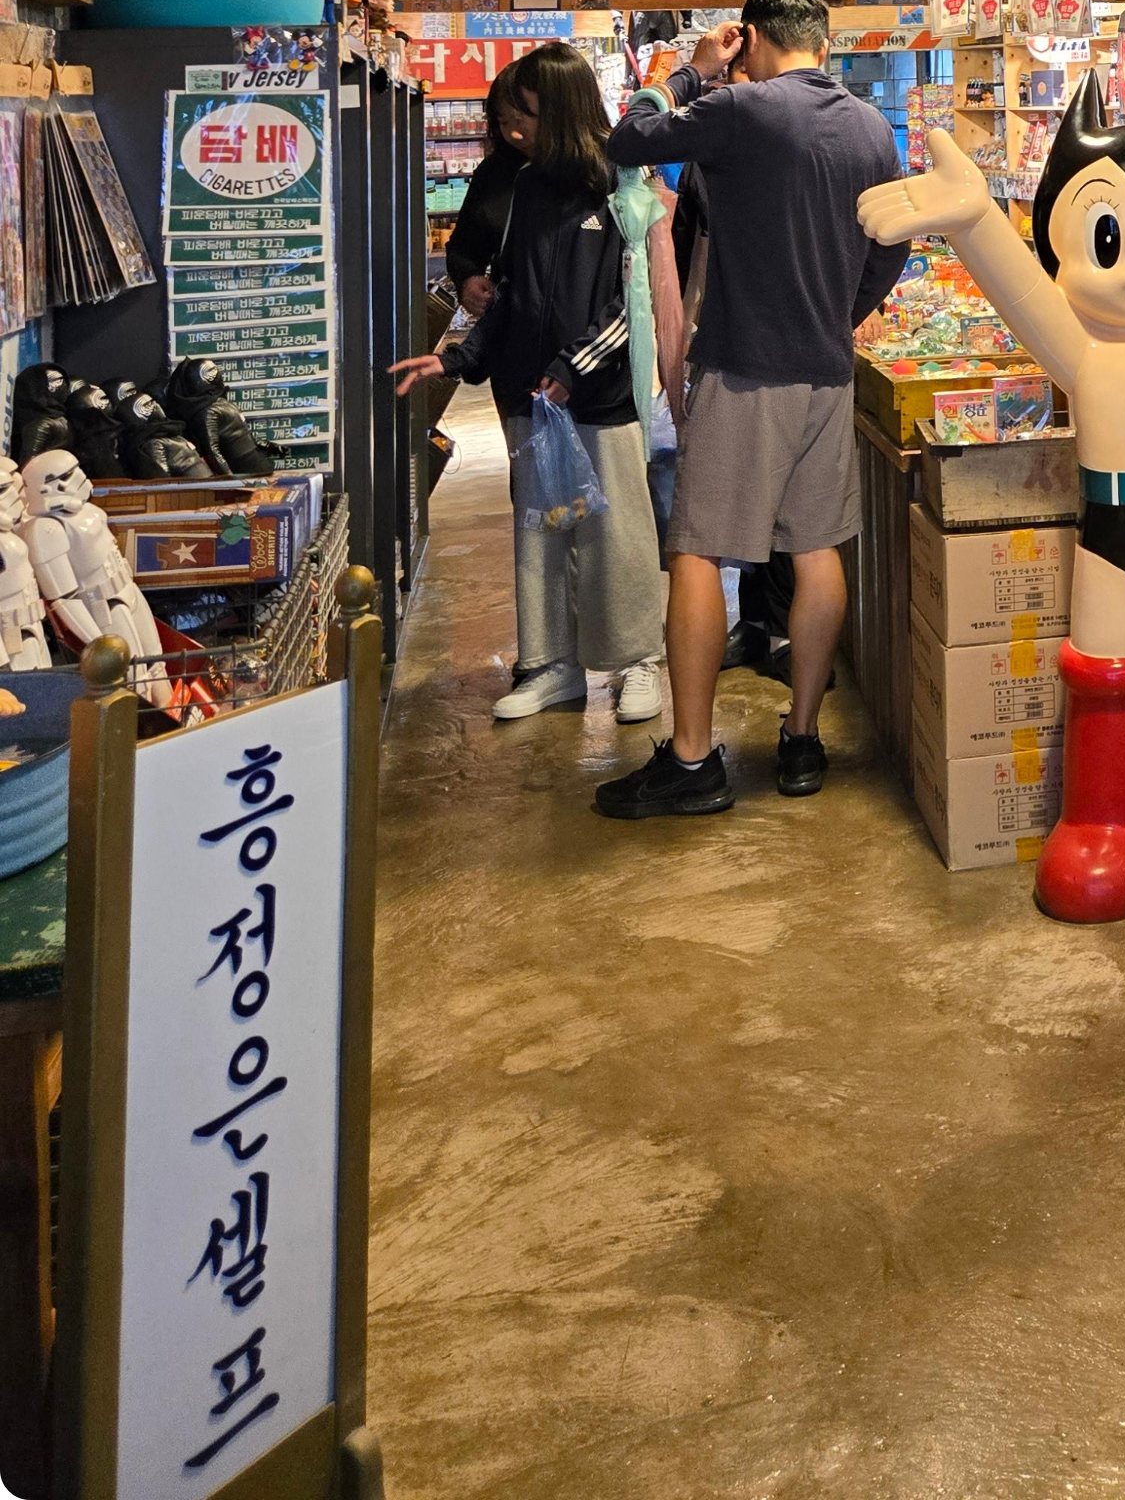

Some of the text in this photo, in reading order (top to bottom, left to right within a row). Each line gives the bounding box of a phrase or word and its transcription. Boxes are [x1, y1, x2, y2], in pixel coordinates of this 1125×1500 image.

[829, 34, 907, 48] NSPORTATION
[243, 67, 310, 90] Jersey
[199, 123, 299, 164] 담배
[198, 167, 297, 196] CIGARETTES
[963, 403, 988, 418] 청춘
[251, 524, 268, 573] Woody
[268, 529, 276, 566] SHERIFF
